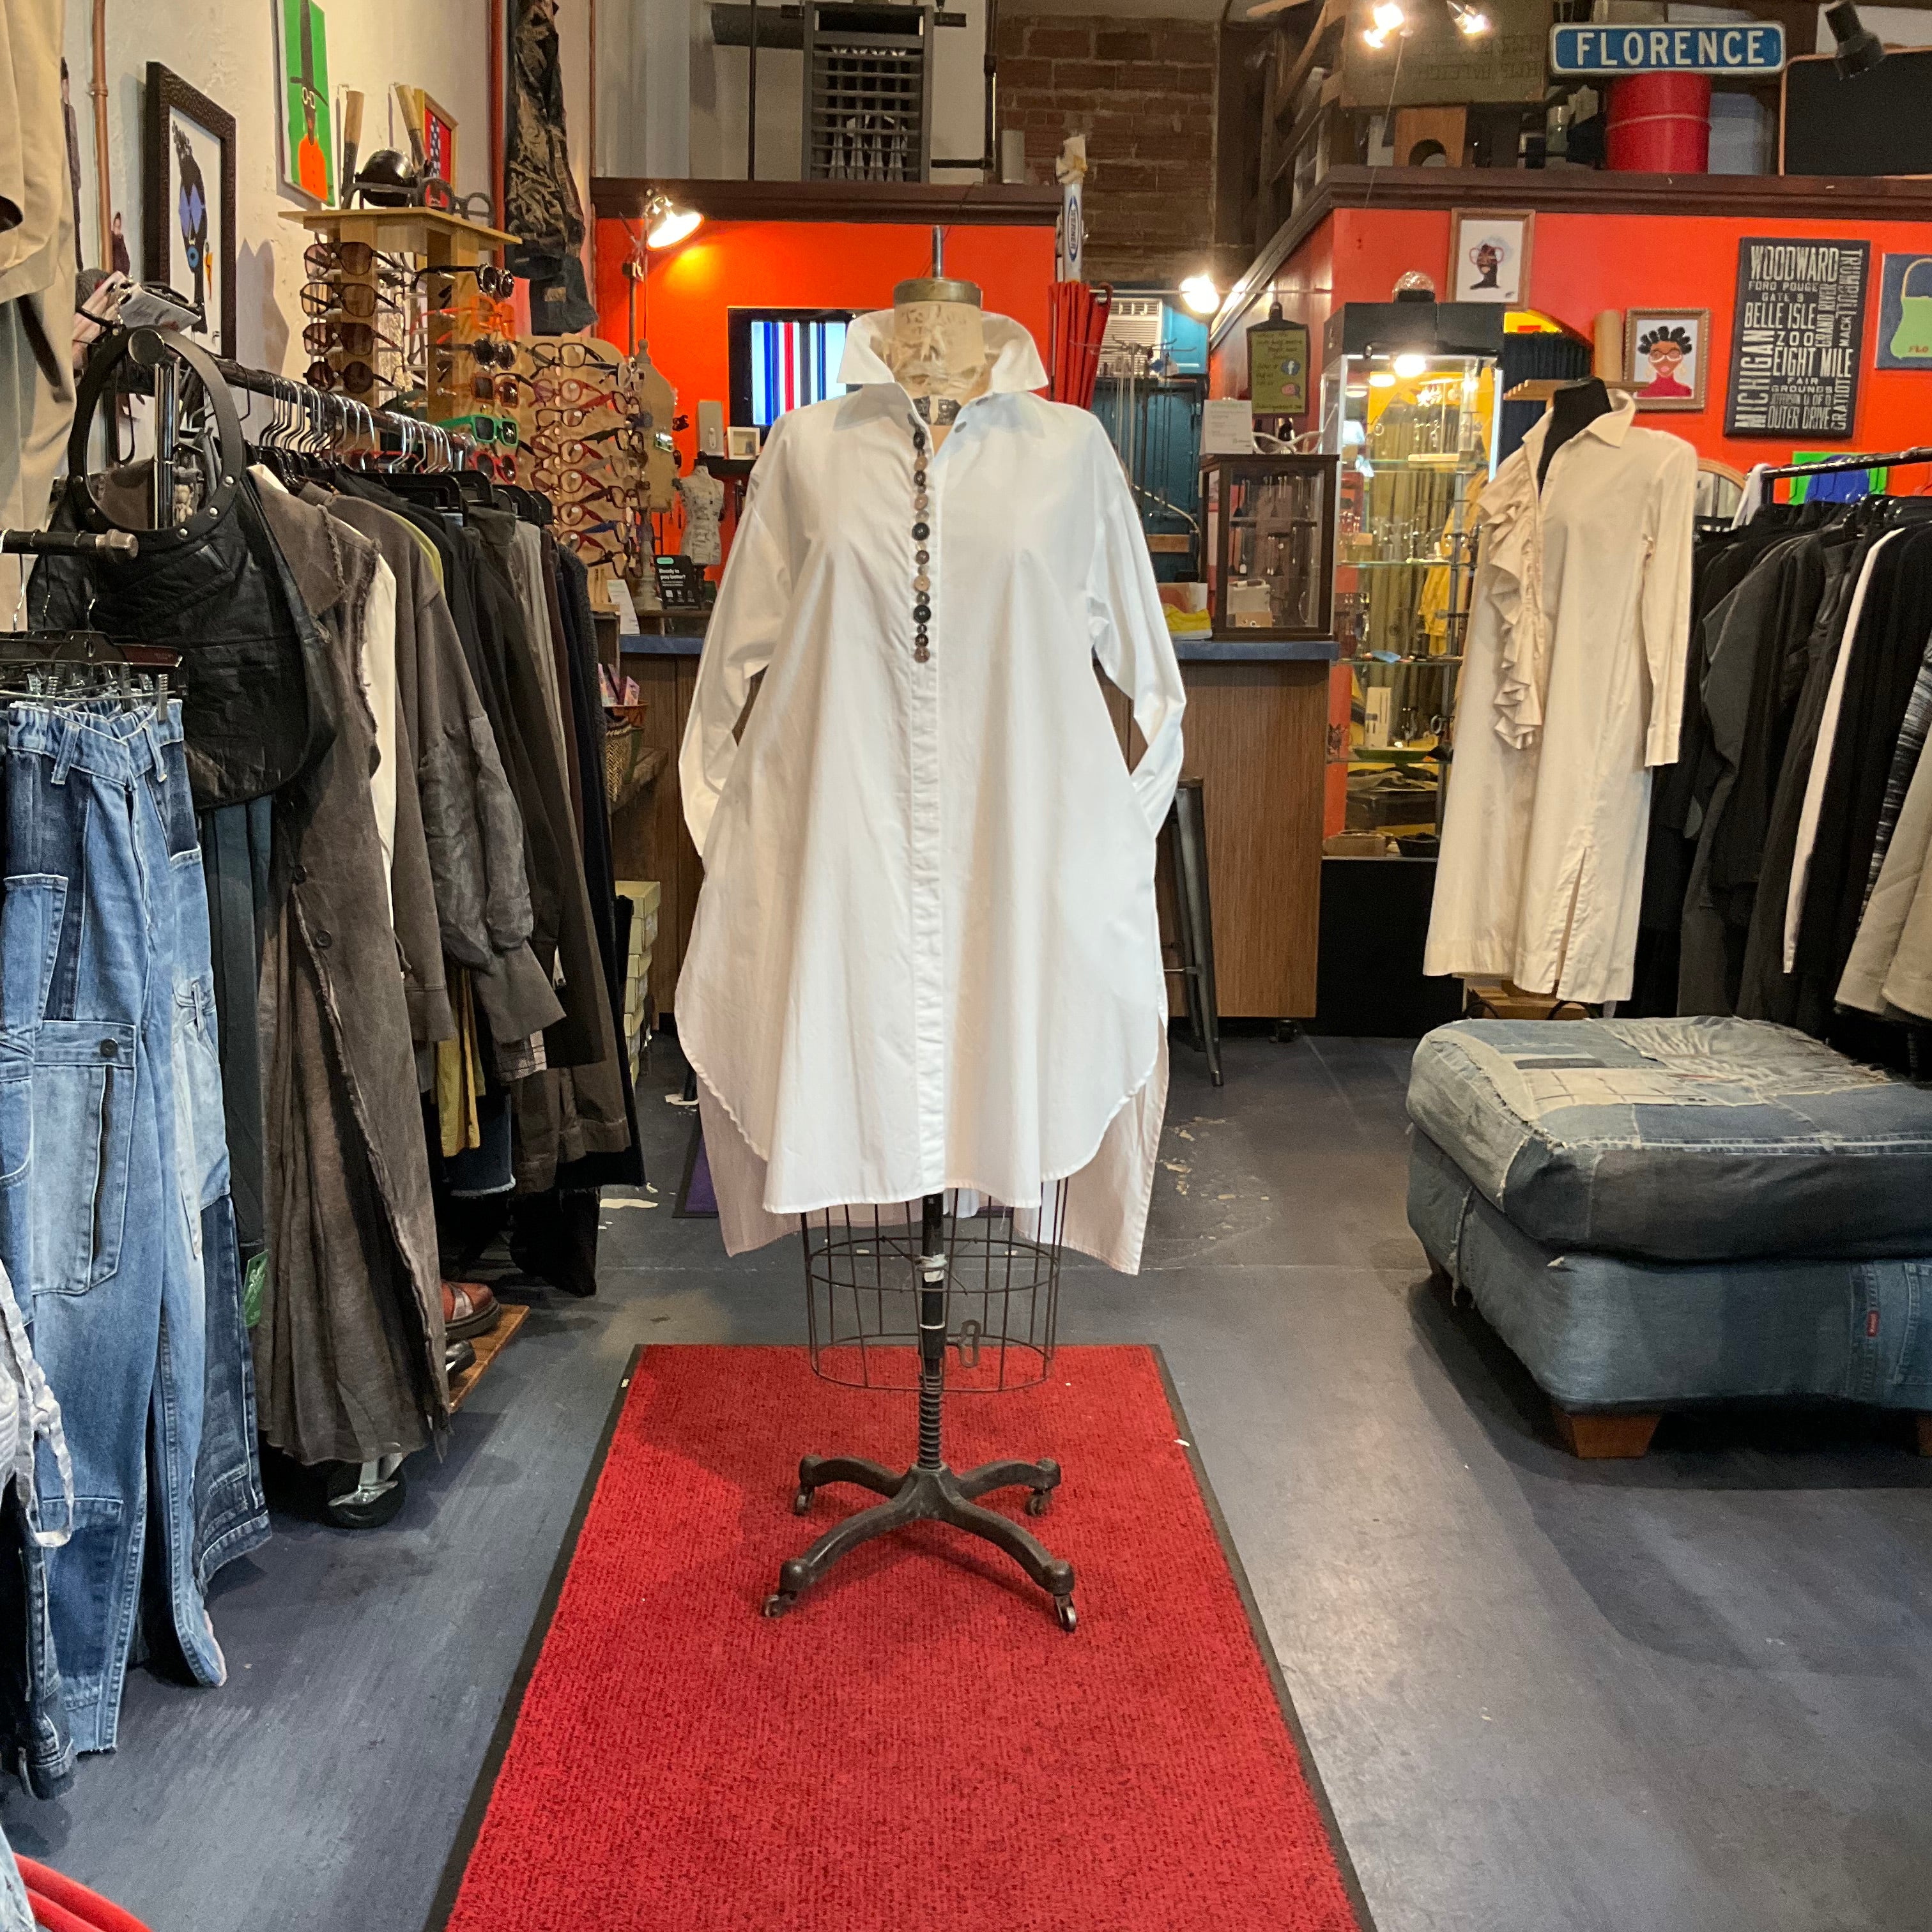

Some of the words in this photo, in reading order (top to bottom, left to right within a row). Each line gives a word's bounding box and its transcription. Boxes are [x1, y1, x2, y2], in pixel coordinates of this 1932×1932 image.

[1577, 31, 1765, 66] FLORENCE
[1751, 246, 1839, 282] WOODWARD
[1748, 281, 1777, 291] FORD
[1835, 249, 1862, 319] TRUMBULL
[1744, 302, 1784, 328] BELLE
[1788, 303, 1816, 330] ISLE
[1815, 314, 1834, 347] GRAND
[1839, 316, 1851, 347] MACK
[1776, 331, 1814, 346] ZOO
[1735, 329, 1775, 427] MICHIGAN
[1773, 347, 1816, 376] EIGHT
[1820, 348, 1853, 378] MILE
[1771, 385, 1832, 394] GROUNDS
[1813, 394, 1823, 405] OF
[1831, 377, 1851, 431] GRATIOT
[1767, 405, 1800, 429] OUTER
[1802, 406, 1832, 429] DRIVE
